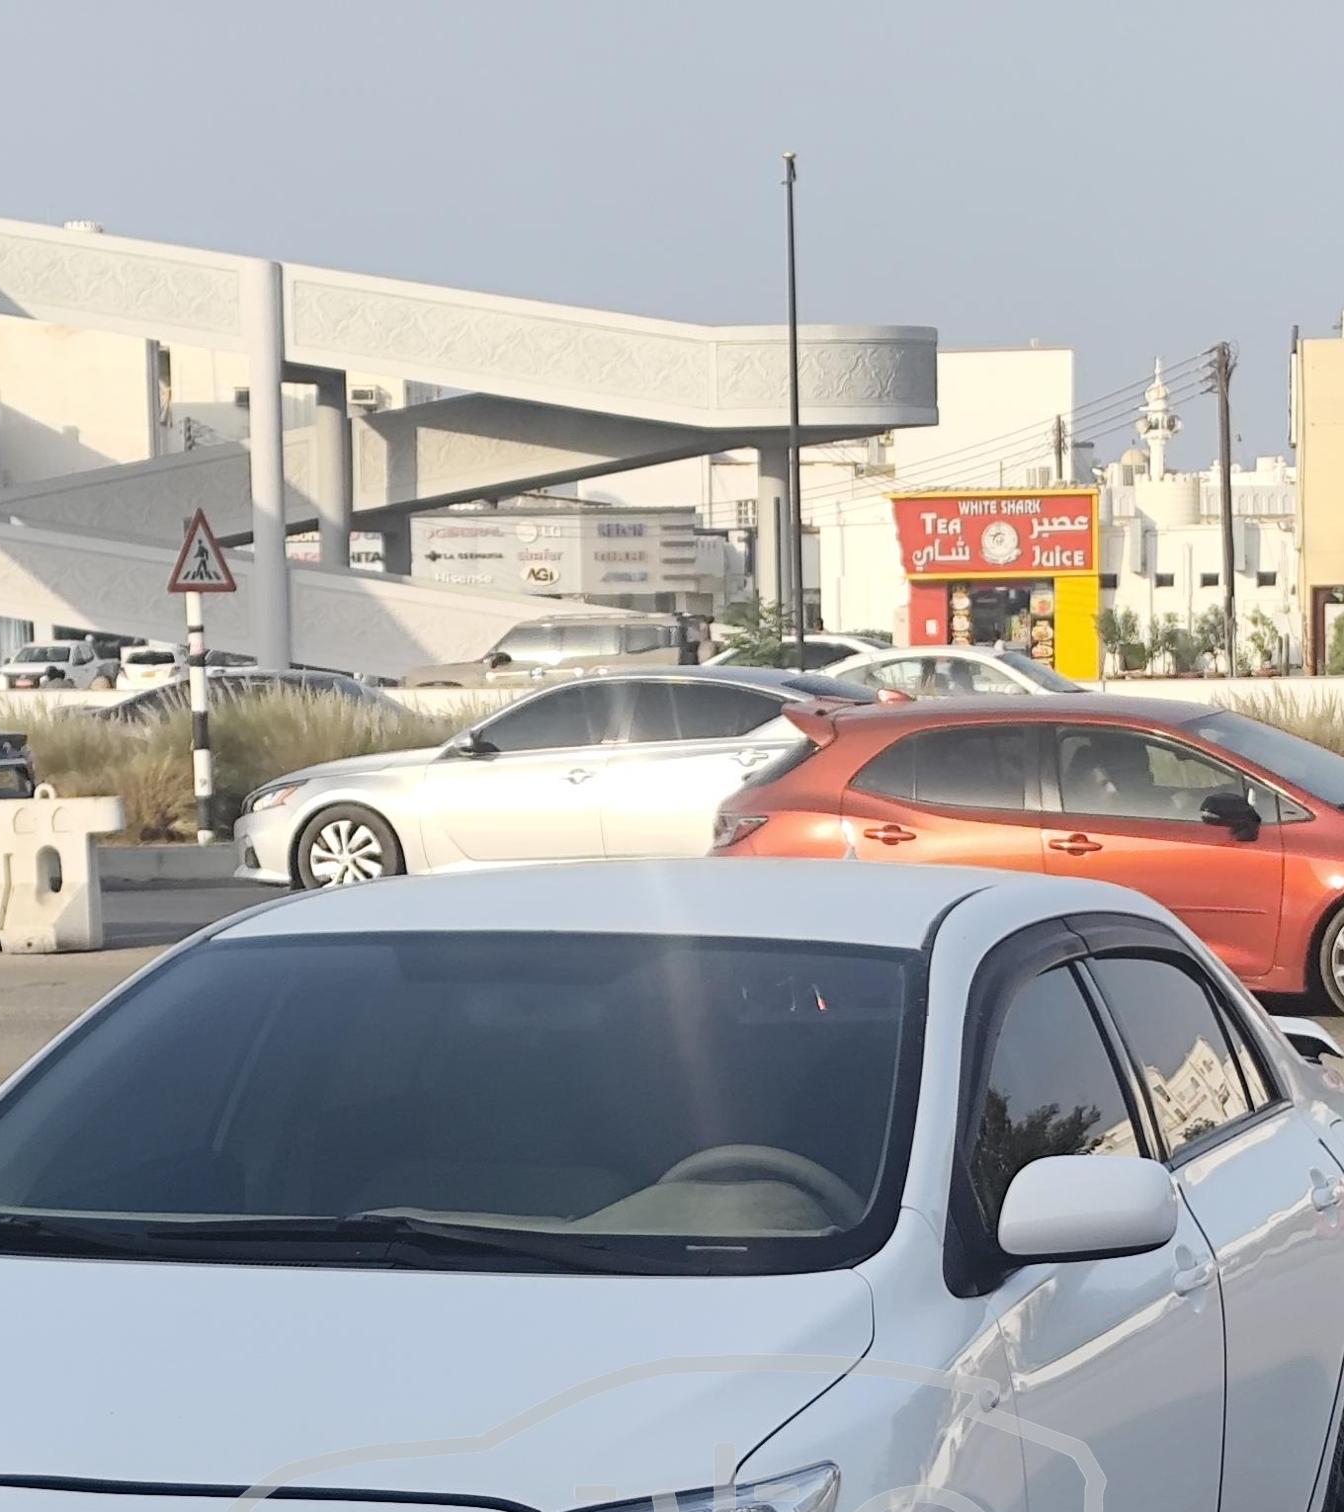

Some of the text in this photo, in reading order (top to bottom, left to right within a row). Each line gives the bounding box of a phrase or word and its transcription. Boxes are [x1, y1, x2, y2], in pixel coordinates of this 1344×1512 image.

[958, 500, 1041, 516] WHITE SHARK
[1029, 515, 1089, 539] عصير
[912, 537, 970, 571] شاي
[435, 571, 494, 585] Hisense
